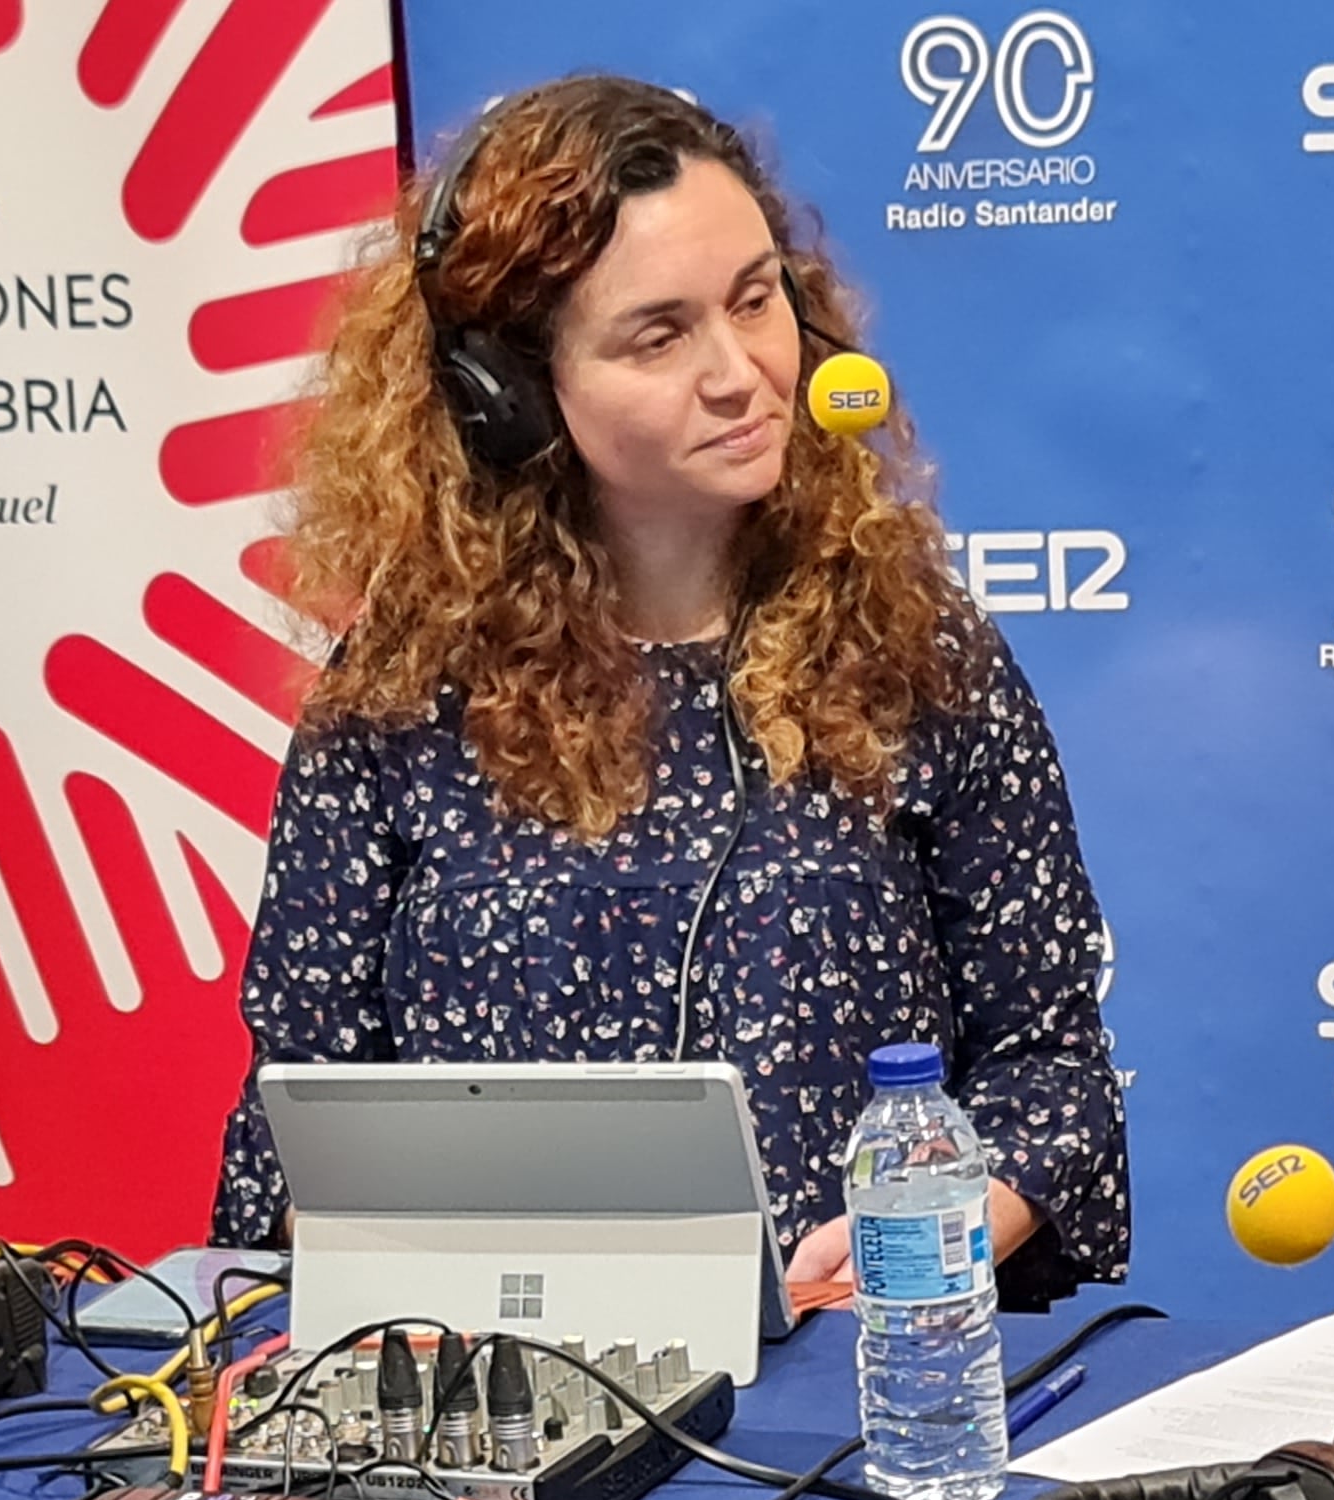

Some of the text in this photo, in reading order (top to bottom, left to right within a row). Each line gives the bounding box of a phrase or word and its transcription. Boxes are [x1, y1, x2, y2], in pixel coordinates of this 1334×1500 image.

[901, 11, 1095, 152] 90
[904, 155, 1096, 191] ANIVERSARIO
[886, 198, 1118, 230] Radio Santander
[829, 389, 881, 409] SER
[1239, 1153, 1307, 1208] SER
